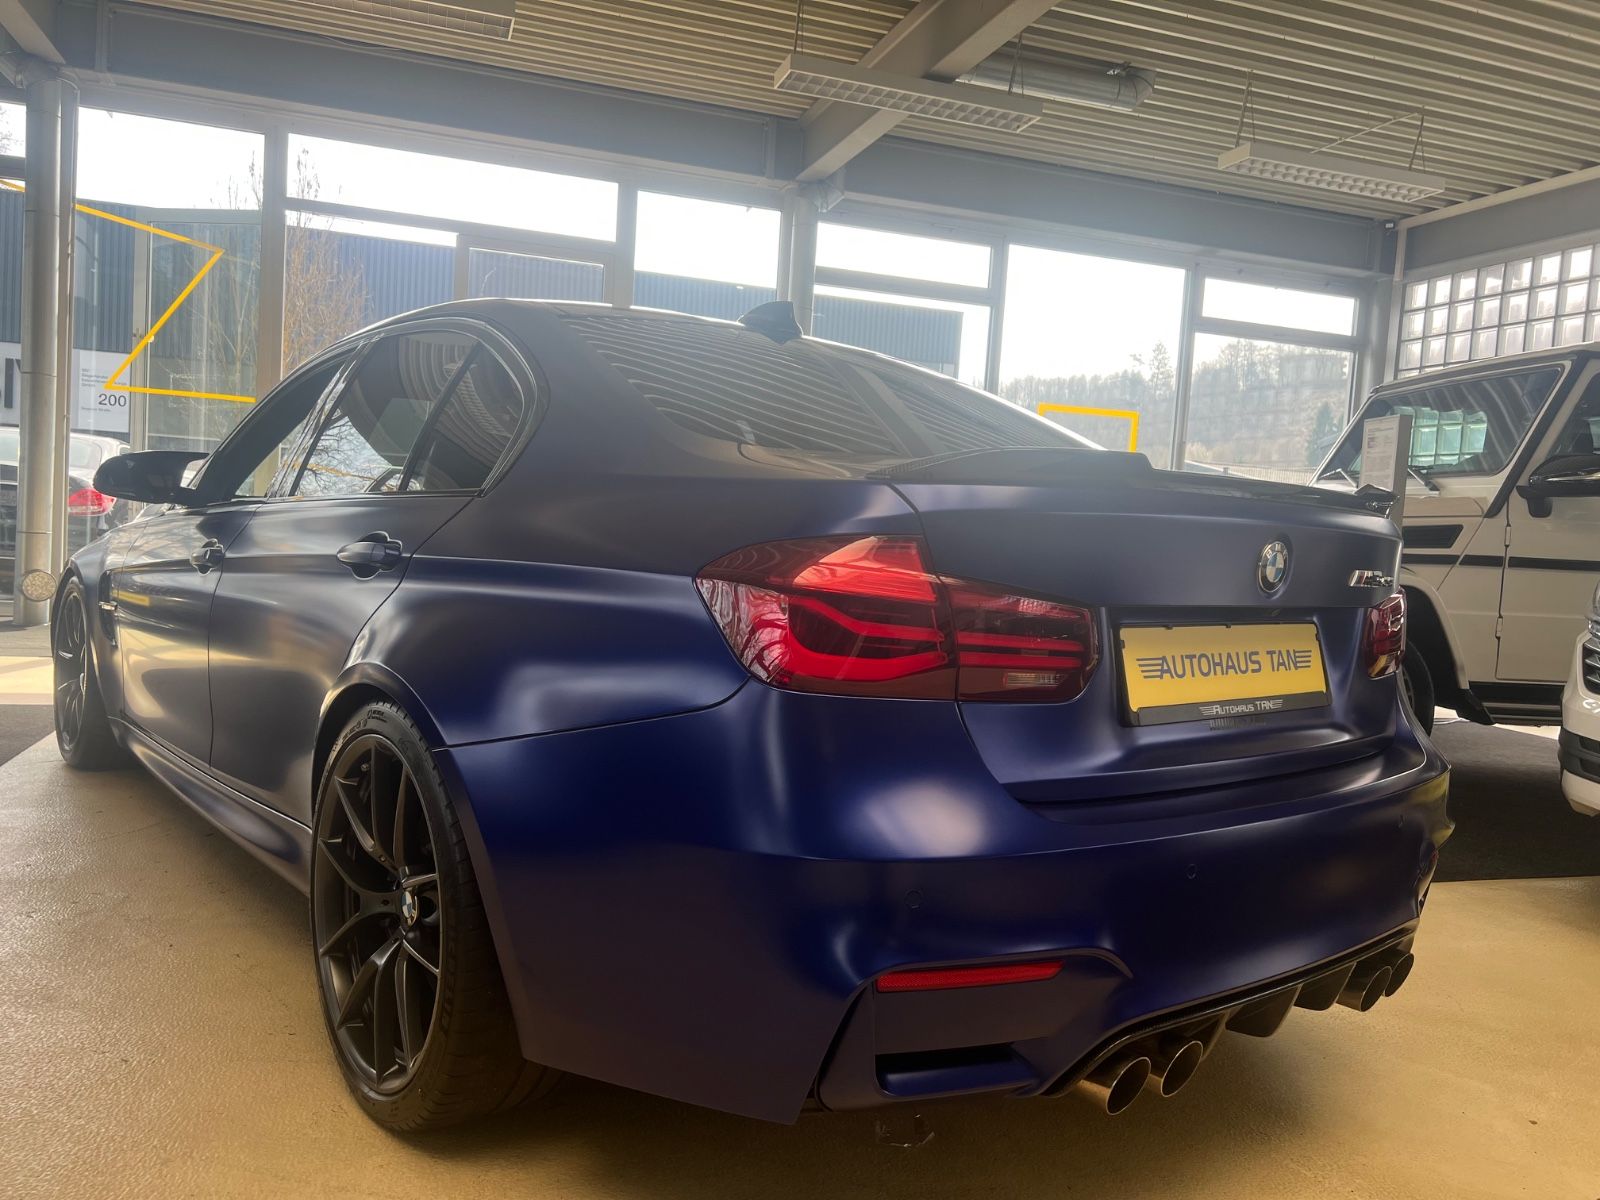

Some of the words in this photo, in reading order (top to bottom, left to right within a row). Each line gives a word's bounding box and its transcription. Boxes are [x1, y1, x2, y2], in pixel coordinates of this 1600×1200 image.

[98, 393, 127, 407] 200
[1160, 651, 1262, 680] AUTOHAUS
[1266, 649, 1298, 673] TAN
[1255, 701, 1274, 711] TAN
